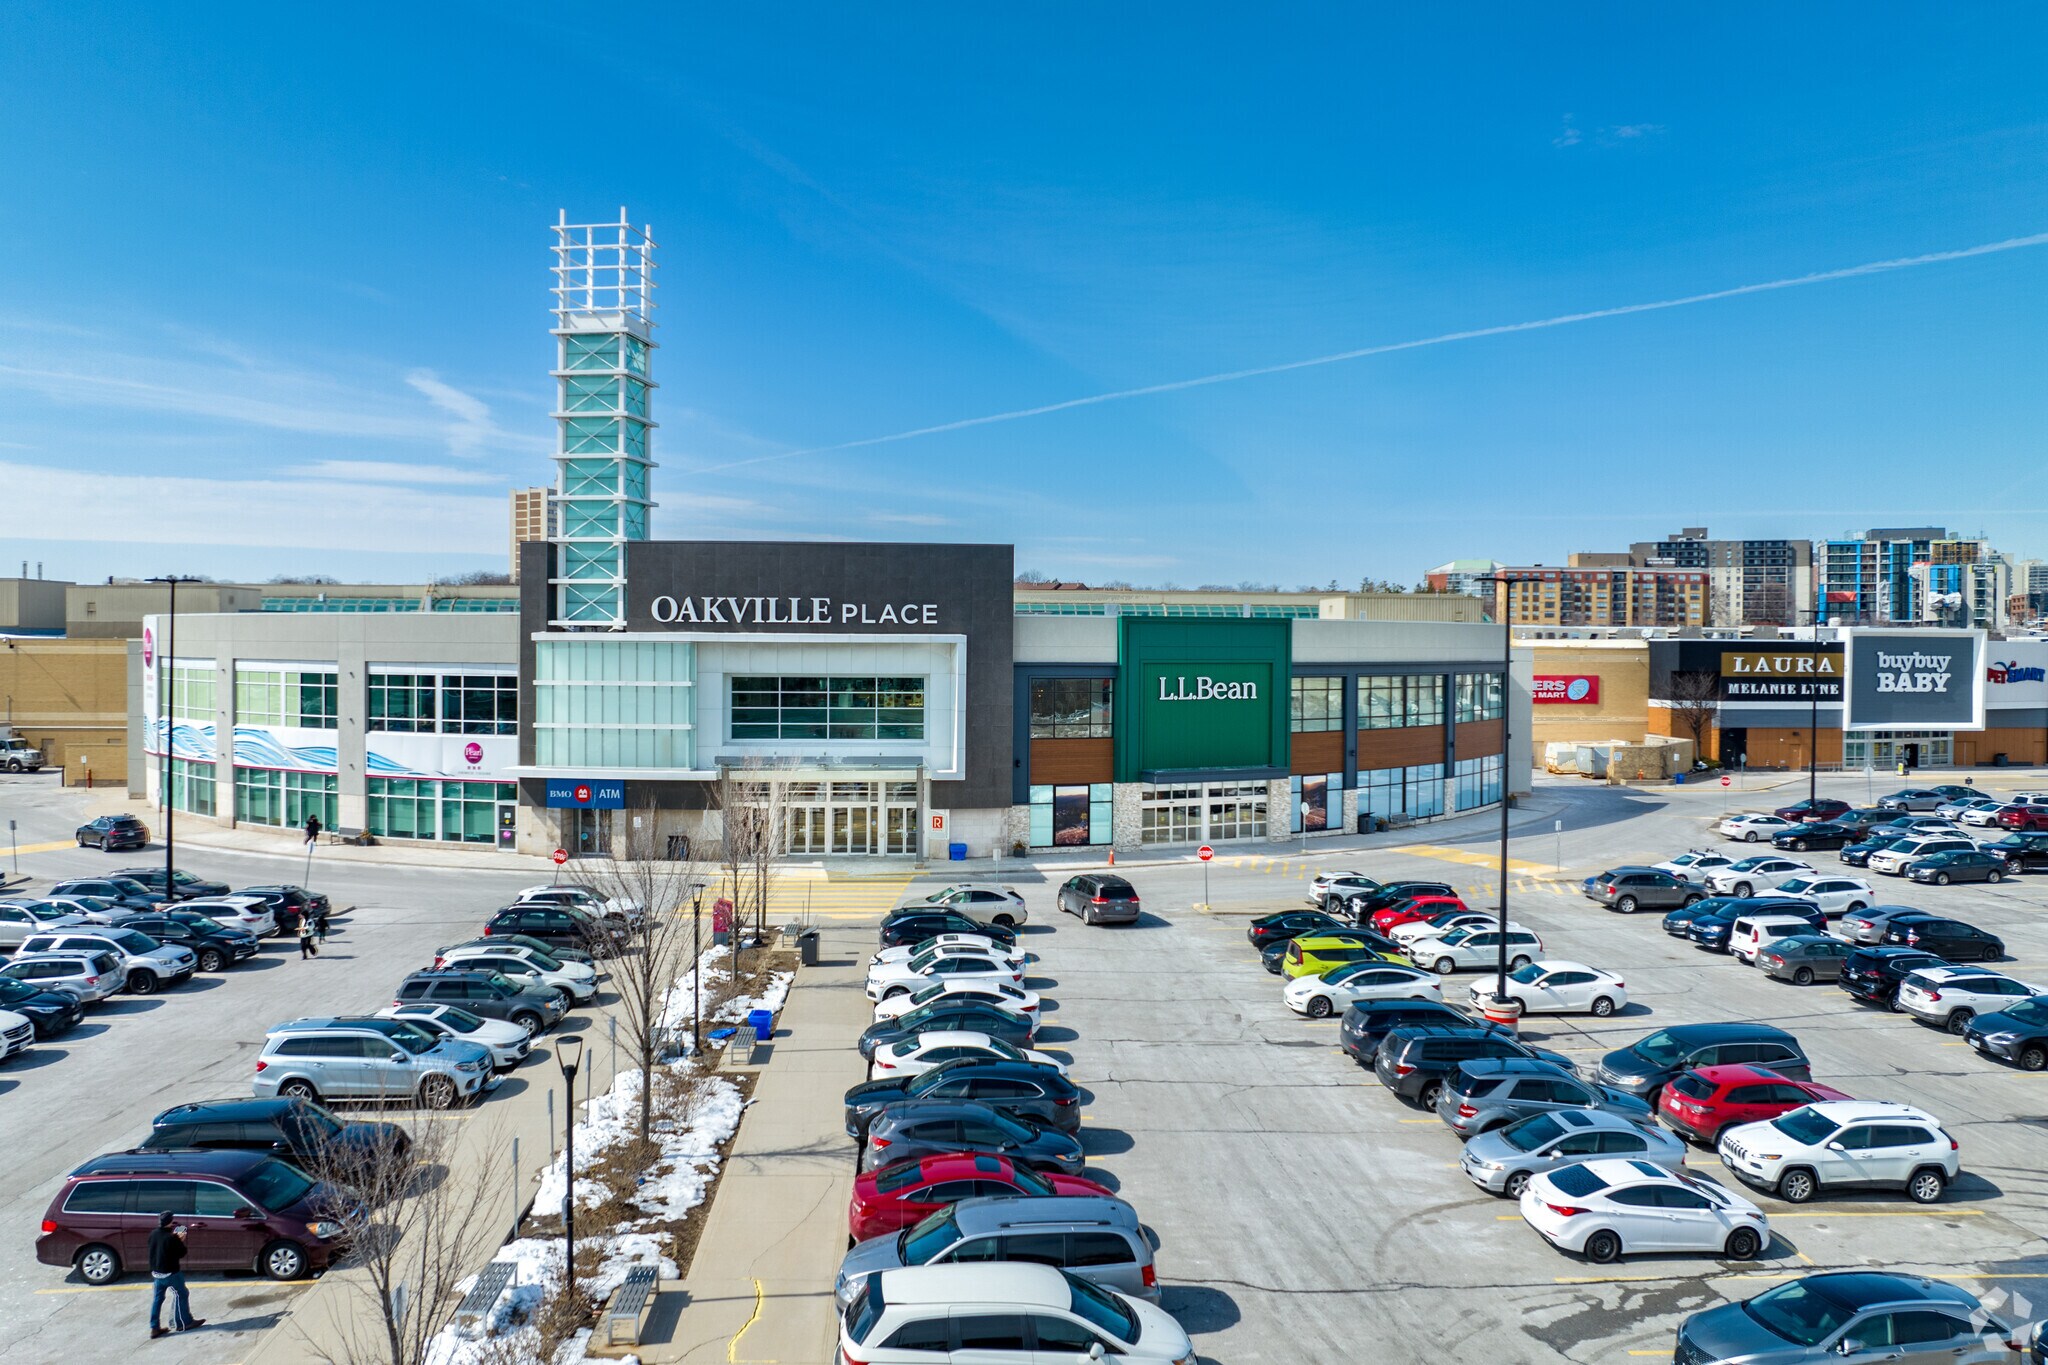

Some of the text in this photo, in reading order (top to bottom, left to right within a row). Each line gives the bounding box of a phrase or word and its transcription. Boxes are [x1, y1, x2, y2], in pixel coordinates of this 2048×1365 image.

[651, 595, 938, 624] OAKVILLE PLACE
[1733, 656, 1835, 673] LAURA
[1877, 651, 1952, 673] buybuy
[1159, 676, 1258, 701] L.L.Bean
[1728, 683, 1796, 695] MELANIE
[1876, 672, 1952, 693] BABY
[1537, 691, 1566, 699] MART
[549, 788, 620, 799] BMO ATM
[553, 852, 567, 860] STOP
